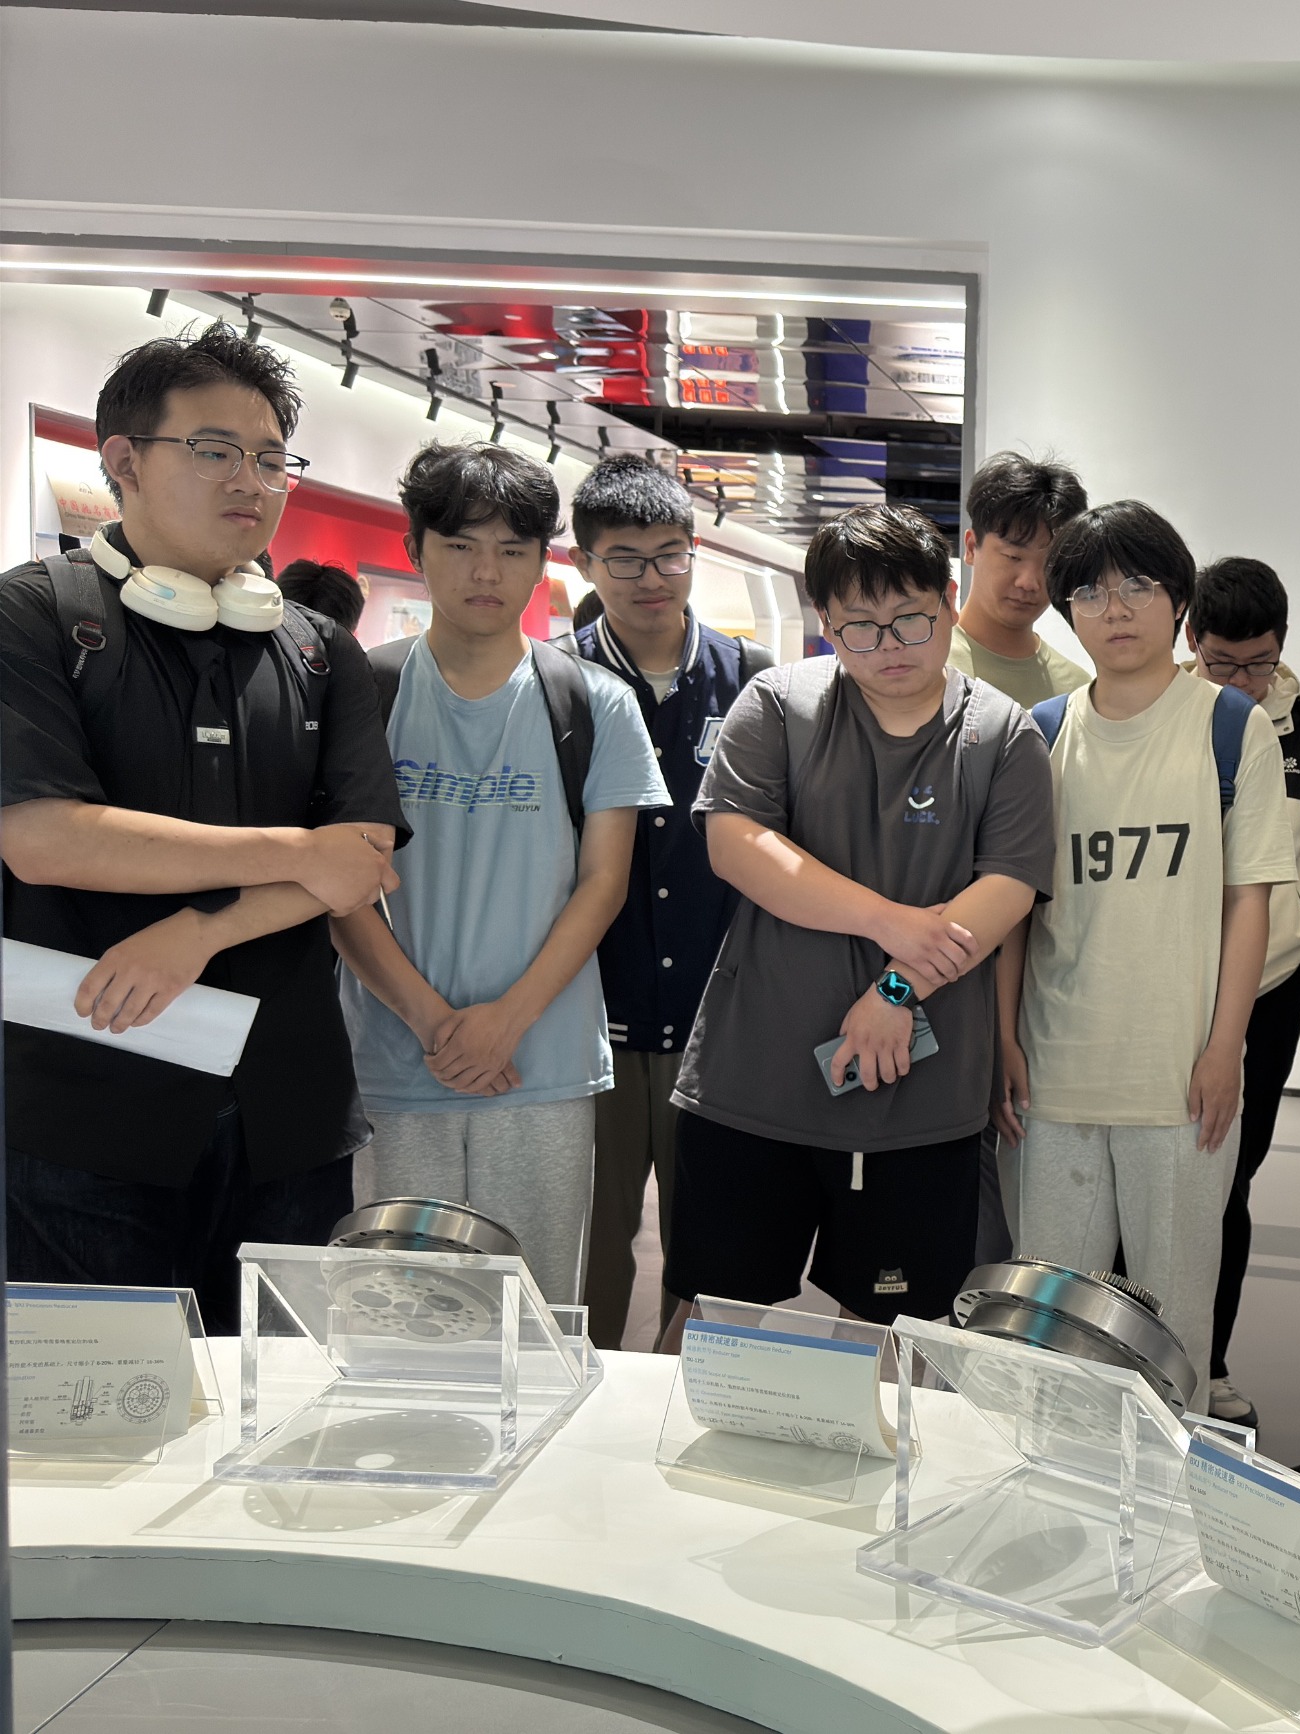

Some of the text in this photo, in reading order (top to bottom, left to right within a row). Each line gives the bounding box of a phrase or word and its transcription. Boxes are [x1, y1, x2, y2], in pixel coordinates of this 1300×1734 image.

[1071, 822, 1191, 885] 1977
[1200, 1460, 1236, 1485] 精密减速器
